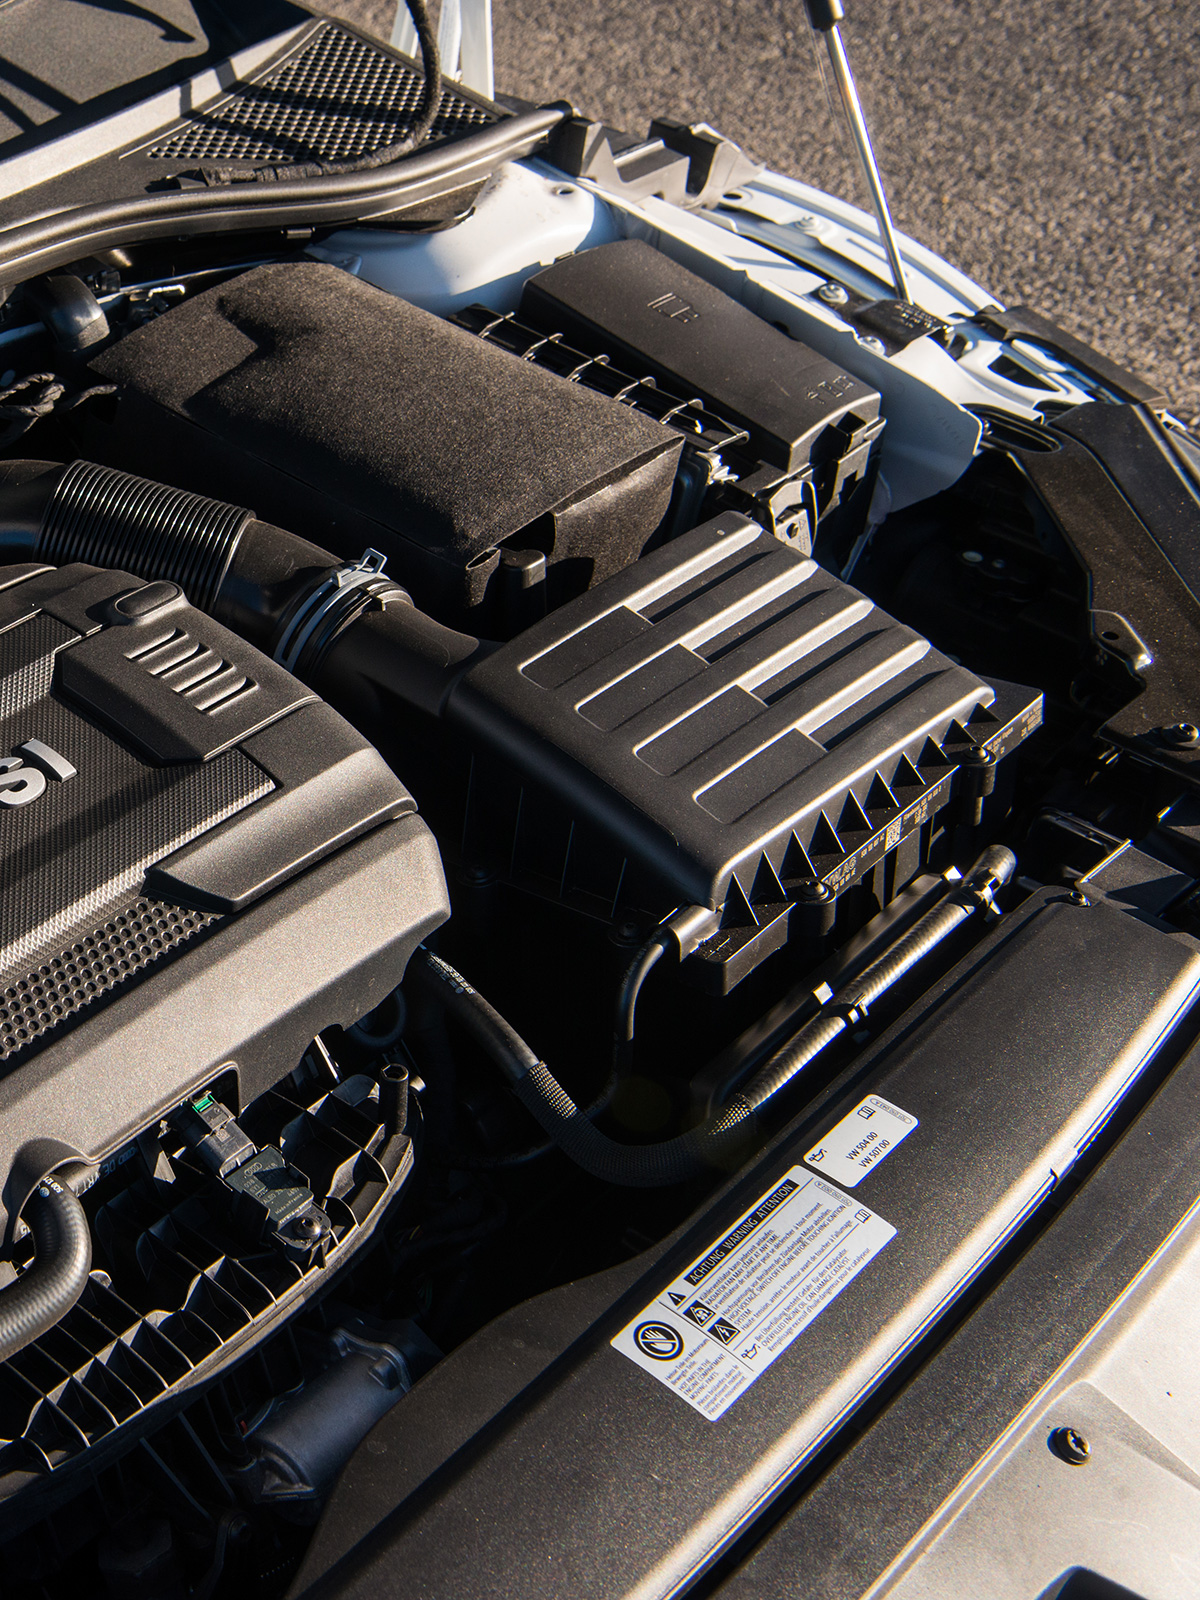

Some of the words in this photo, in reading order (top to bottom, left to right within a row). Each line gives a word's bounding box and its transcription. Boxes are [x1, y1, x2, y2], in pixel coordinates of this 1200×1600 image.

[846, 1149, 860, 1160] VW
[856, 1139, 870, 1150] 504
[866, 1132, 878, 1141] 00
[860, 1157, 873, 1167] VW
[869, 1147, 882, 1158] 507
[879, 1140, 890, 1148] 00
[689, 1249, 726, 1283] ACHTUNG
[722, 1218, 759, 1250] WARNING
[755, 1184, 794, 1219] ATTENTION
[705, 1285, 726, 1305] RADIATOR
[724, 1277, 735, 1286] FAN
[733, 1268, 744, 1278] MAY
[727, 1308, 741, 1321] HIGH
